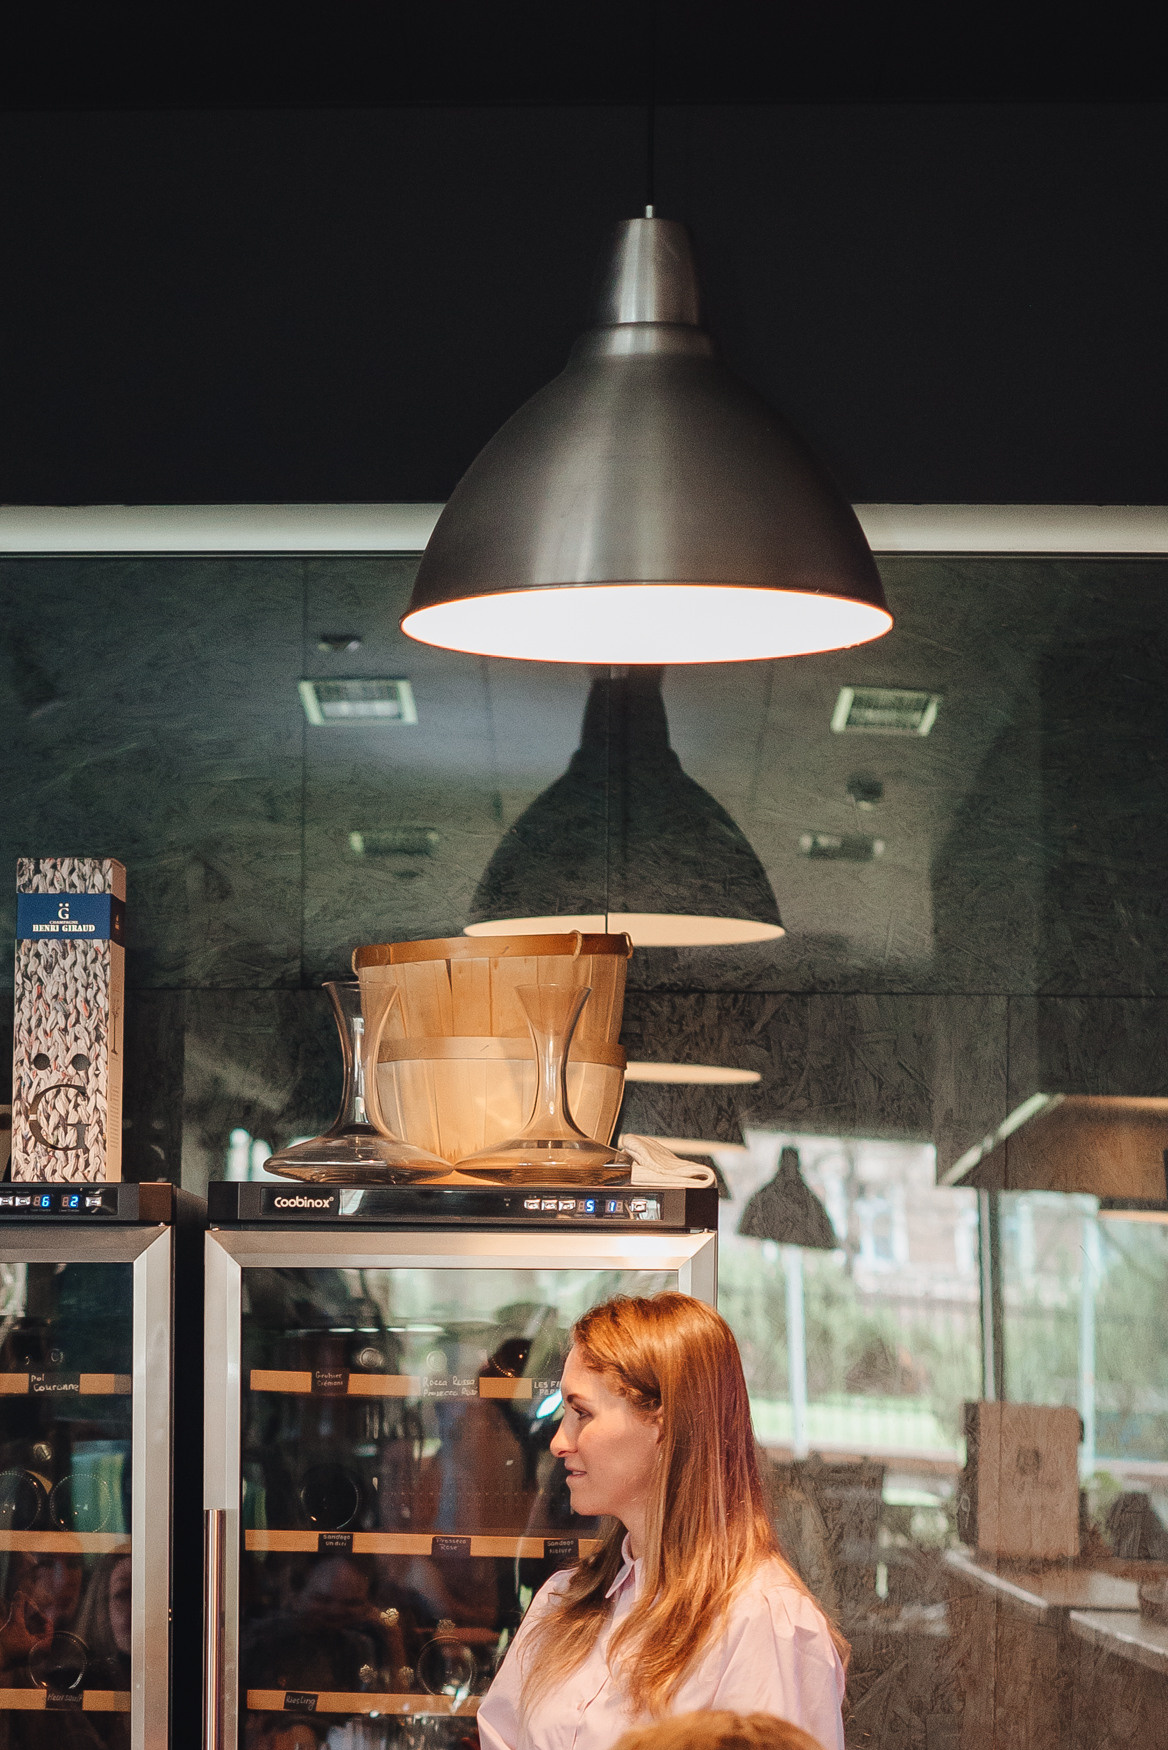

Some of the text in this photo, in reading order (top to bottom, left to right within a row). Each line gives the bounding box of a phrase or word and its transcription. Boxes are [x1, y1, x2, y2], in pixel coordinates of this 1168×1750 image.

[32, 924, 96, 932] HENRI GIRAUD
[41, 1195, 50, 1207] 6
[70, 1195, 79, 1207] 2
[274, 1196, 330, 1208] Coobinox
[31, 1373, 45, 1382] Pol
